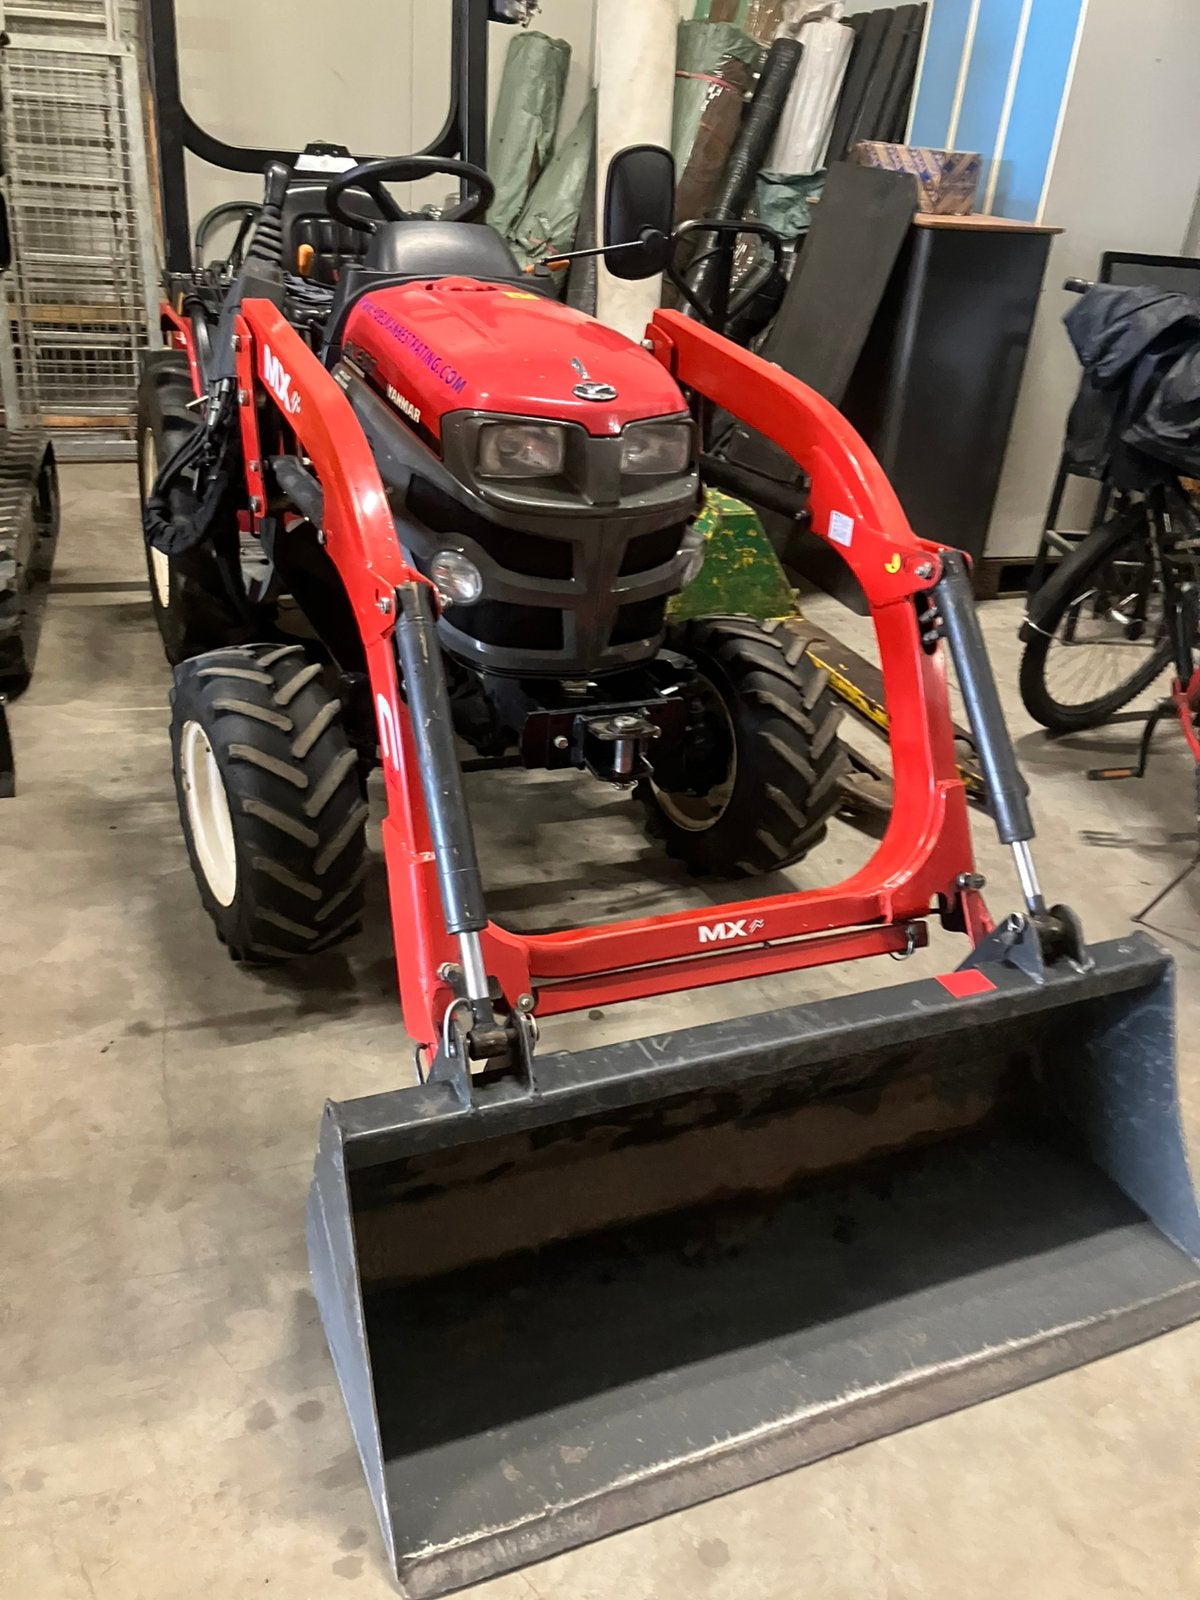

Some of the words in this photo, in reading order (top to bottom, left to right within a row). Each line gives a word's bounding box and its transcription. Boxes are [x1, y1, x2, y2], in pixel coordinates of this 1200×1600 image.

[263, 343, 293, 413] MX
[386, 383, 422, 423] YANMAR
[697, 919, 748, 943] MX
